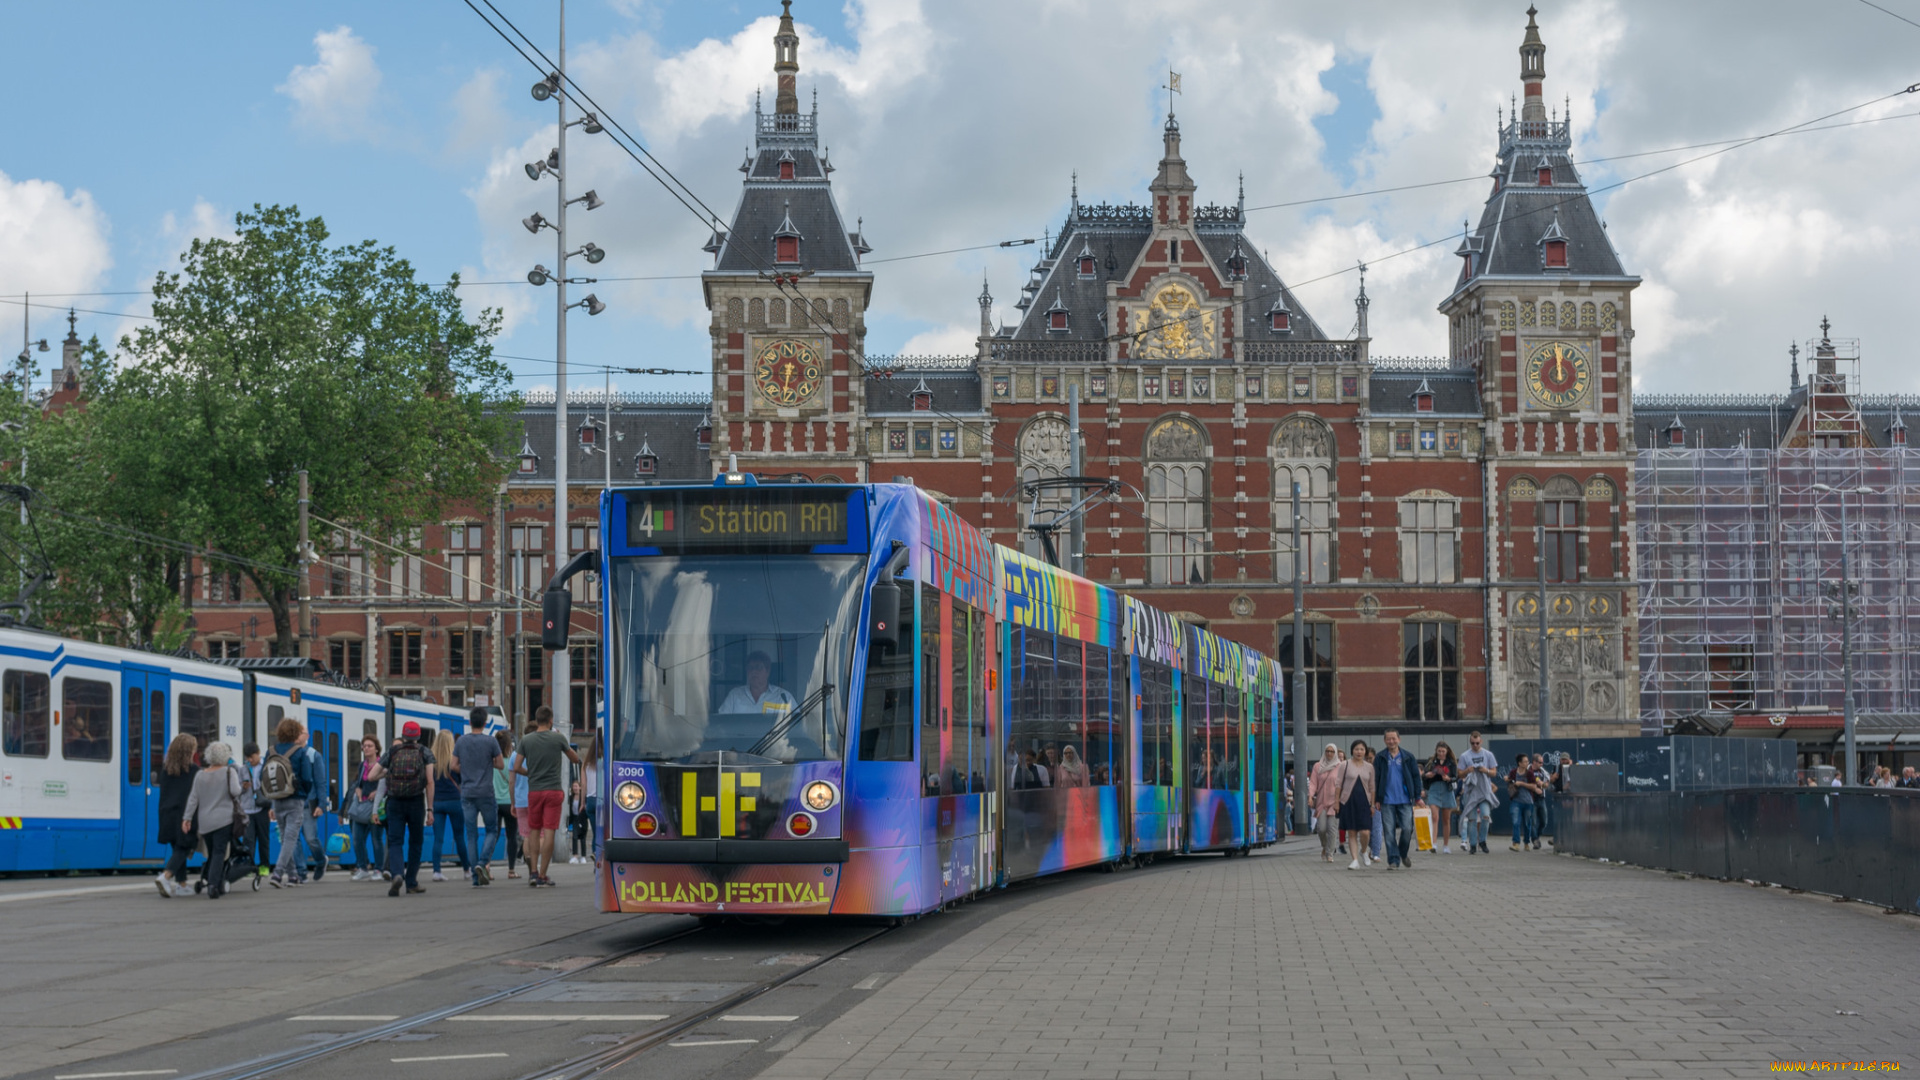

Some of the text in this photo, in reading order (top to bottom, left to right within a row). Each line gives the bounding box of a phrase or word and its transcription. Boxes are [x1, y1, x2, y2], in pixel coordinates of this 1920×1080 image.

[783, 344, 794, 355] N
[806, 367, 818, 379] O
[639, 501, 653, 538] 4
[700, 503, 838, 534] Station RAI
[618, 767, 645, 777] 2090
[620, 880, 830, 903] HOLLAND FESTIVAL
